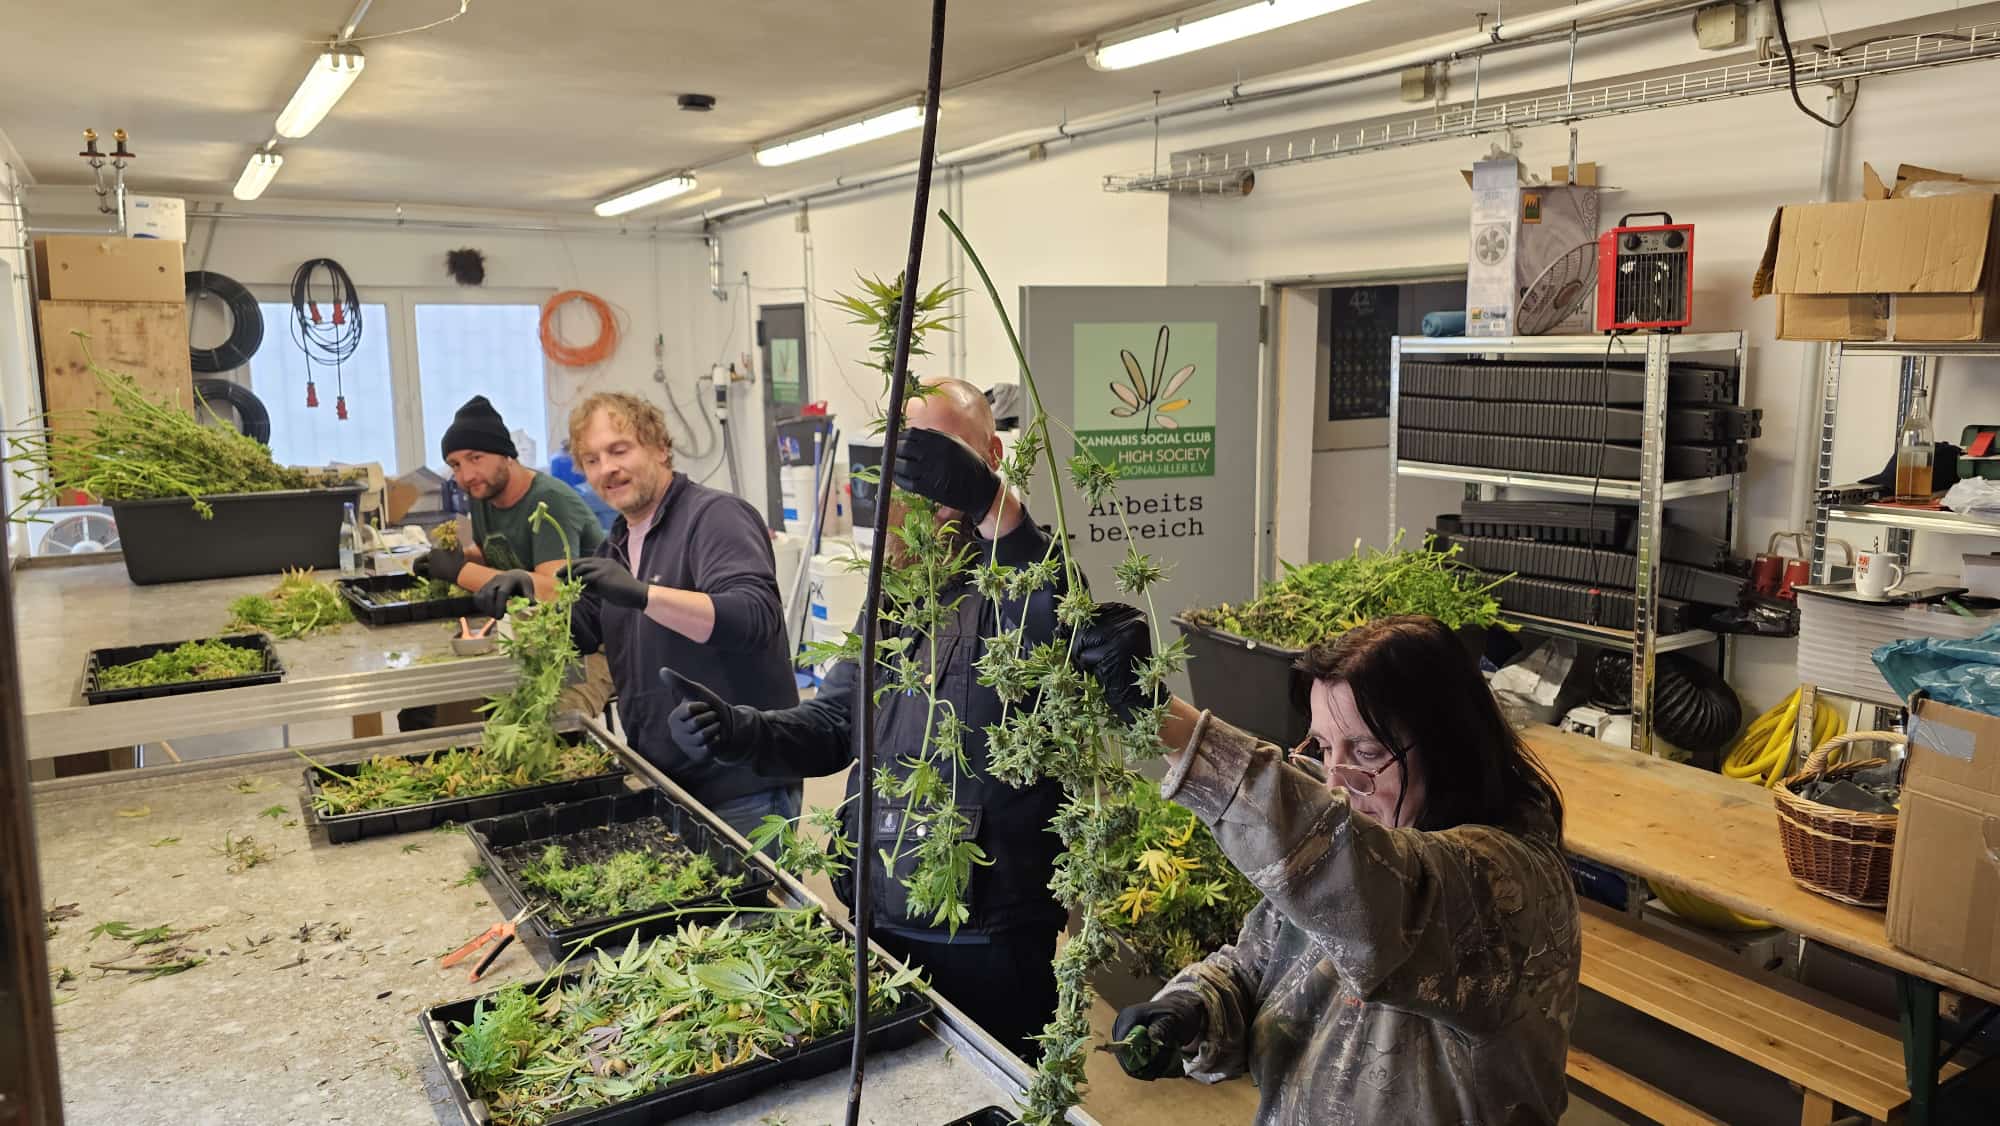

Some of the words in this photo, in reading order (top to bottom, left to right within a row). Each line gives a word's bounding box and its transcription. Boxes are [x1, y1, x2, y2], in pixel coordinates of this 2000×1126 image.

[1079, 434, 1138, 447] CANNABIS
[1140, 432, 1181, 445] SOCIAL
[1183, 431, 1211, 443] CLUB
[1118, 450, 1153, 464] HIGH
[1156, 447, 1210, 462] SOCIETY
[1088, 493, 1203, 517] Arbeits
[1089, 517, 1204, 543] bereich
